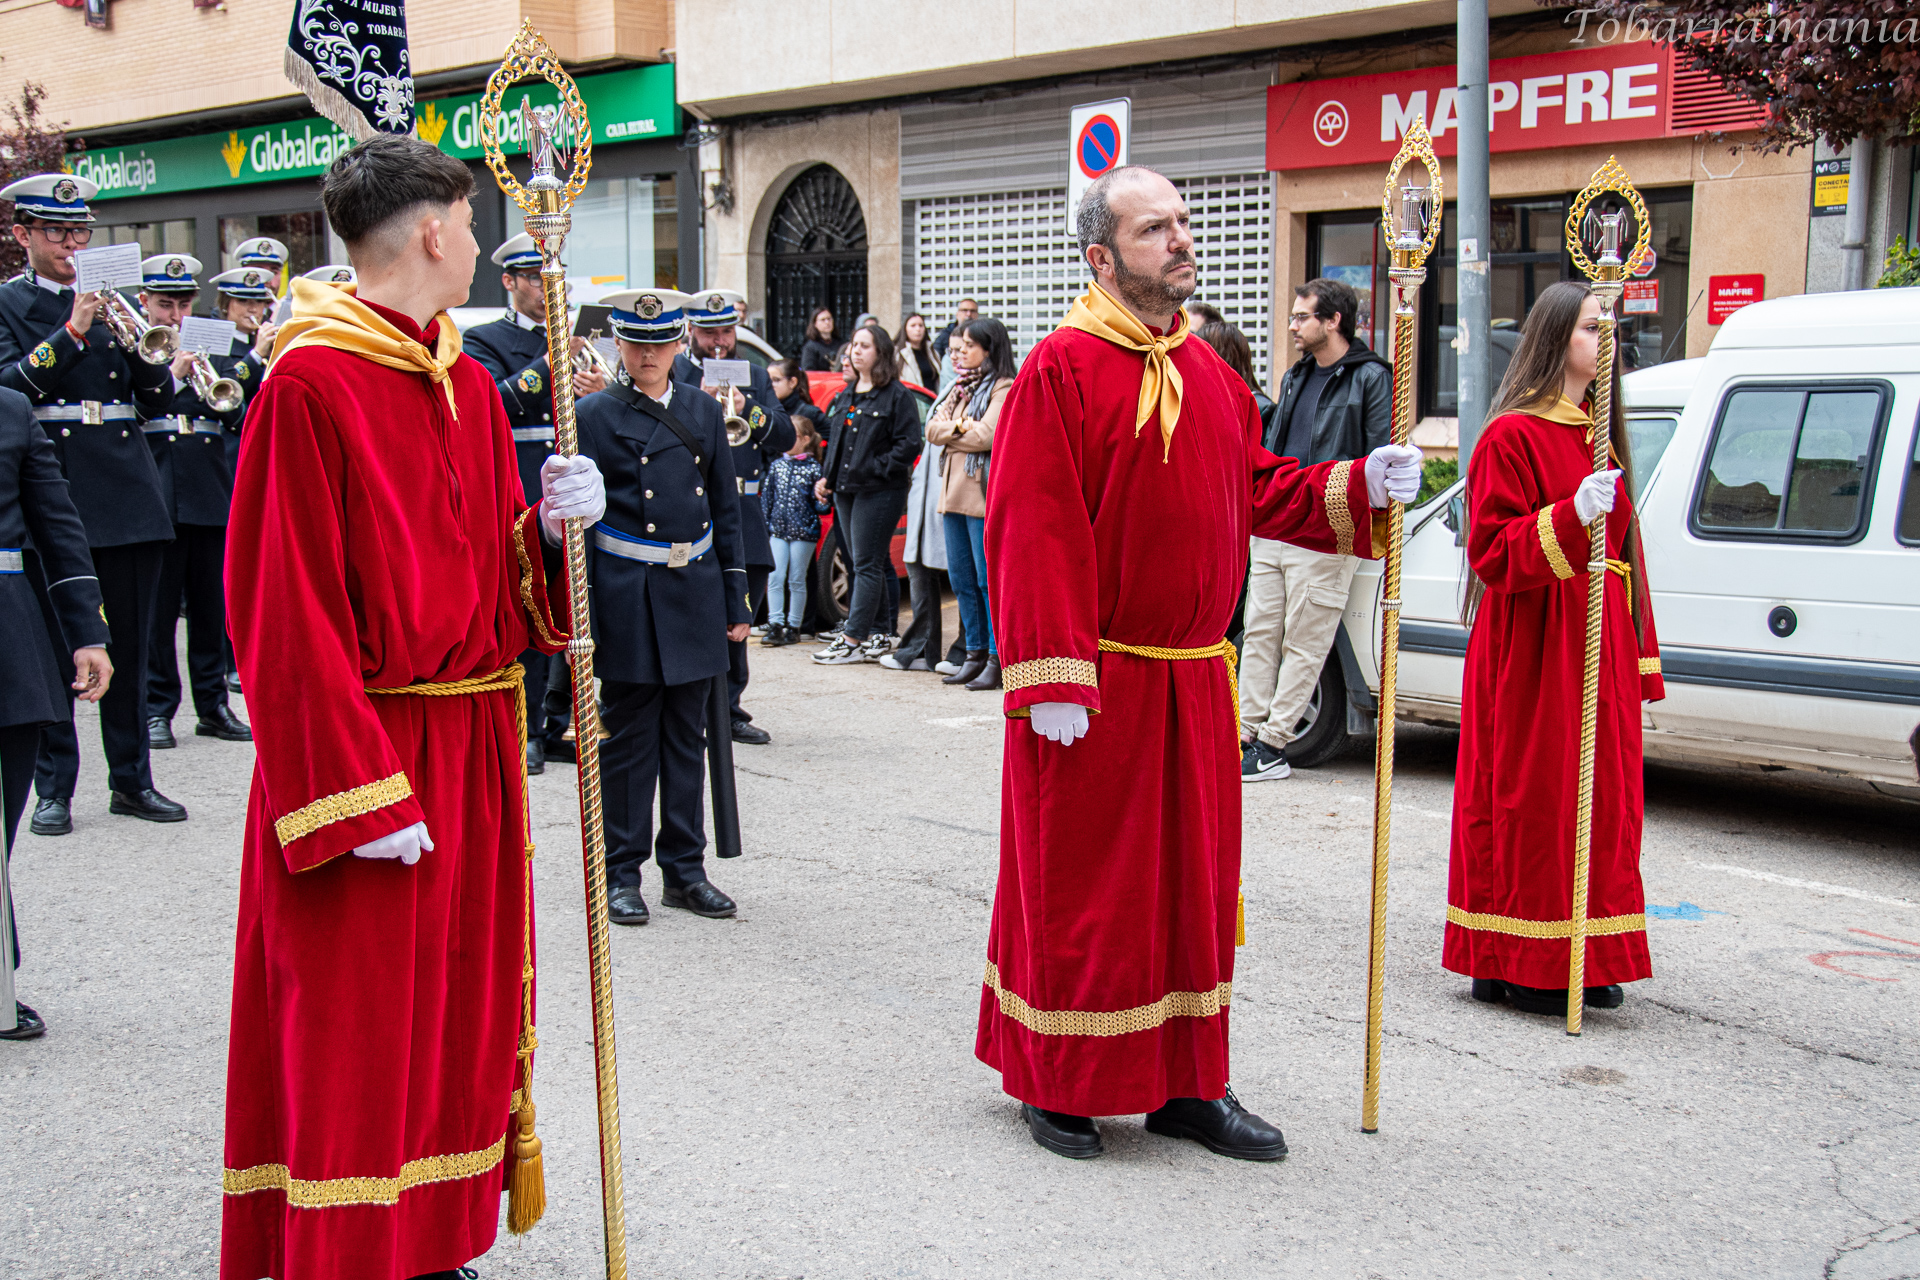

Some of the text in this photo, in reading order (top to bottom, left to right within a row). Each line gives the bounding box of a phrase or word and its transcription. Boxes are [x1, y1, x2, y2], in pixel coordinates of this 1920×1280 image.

[362, 0, 397, 17] MUJER
[1381, 63, 1658, 142] MAPFRE
[605, 119, 657, 138] CAJA RURAL
[1718, 288, 1754, 296] MAPFRE
